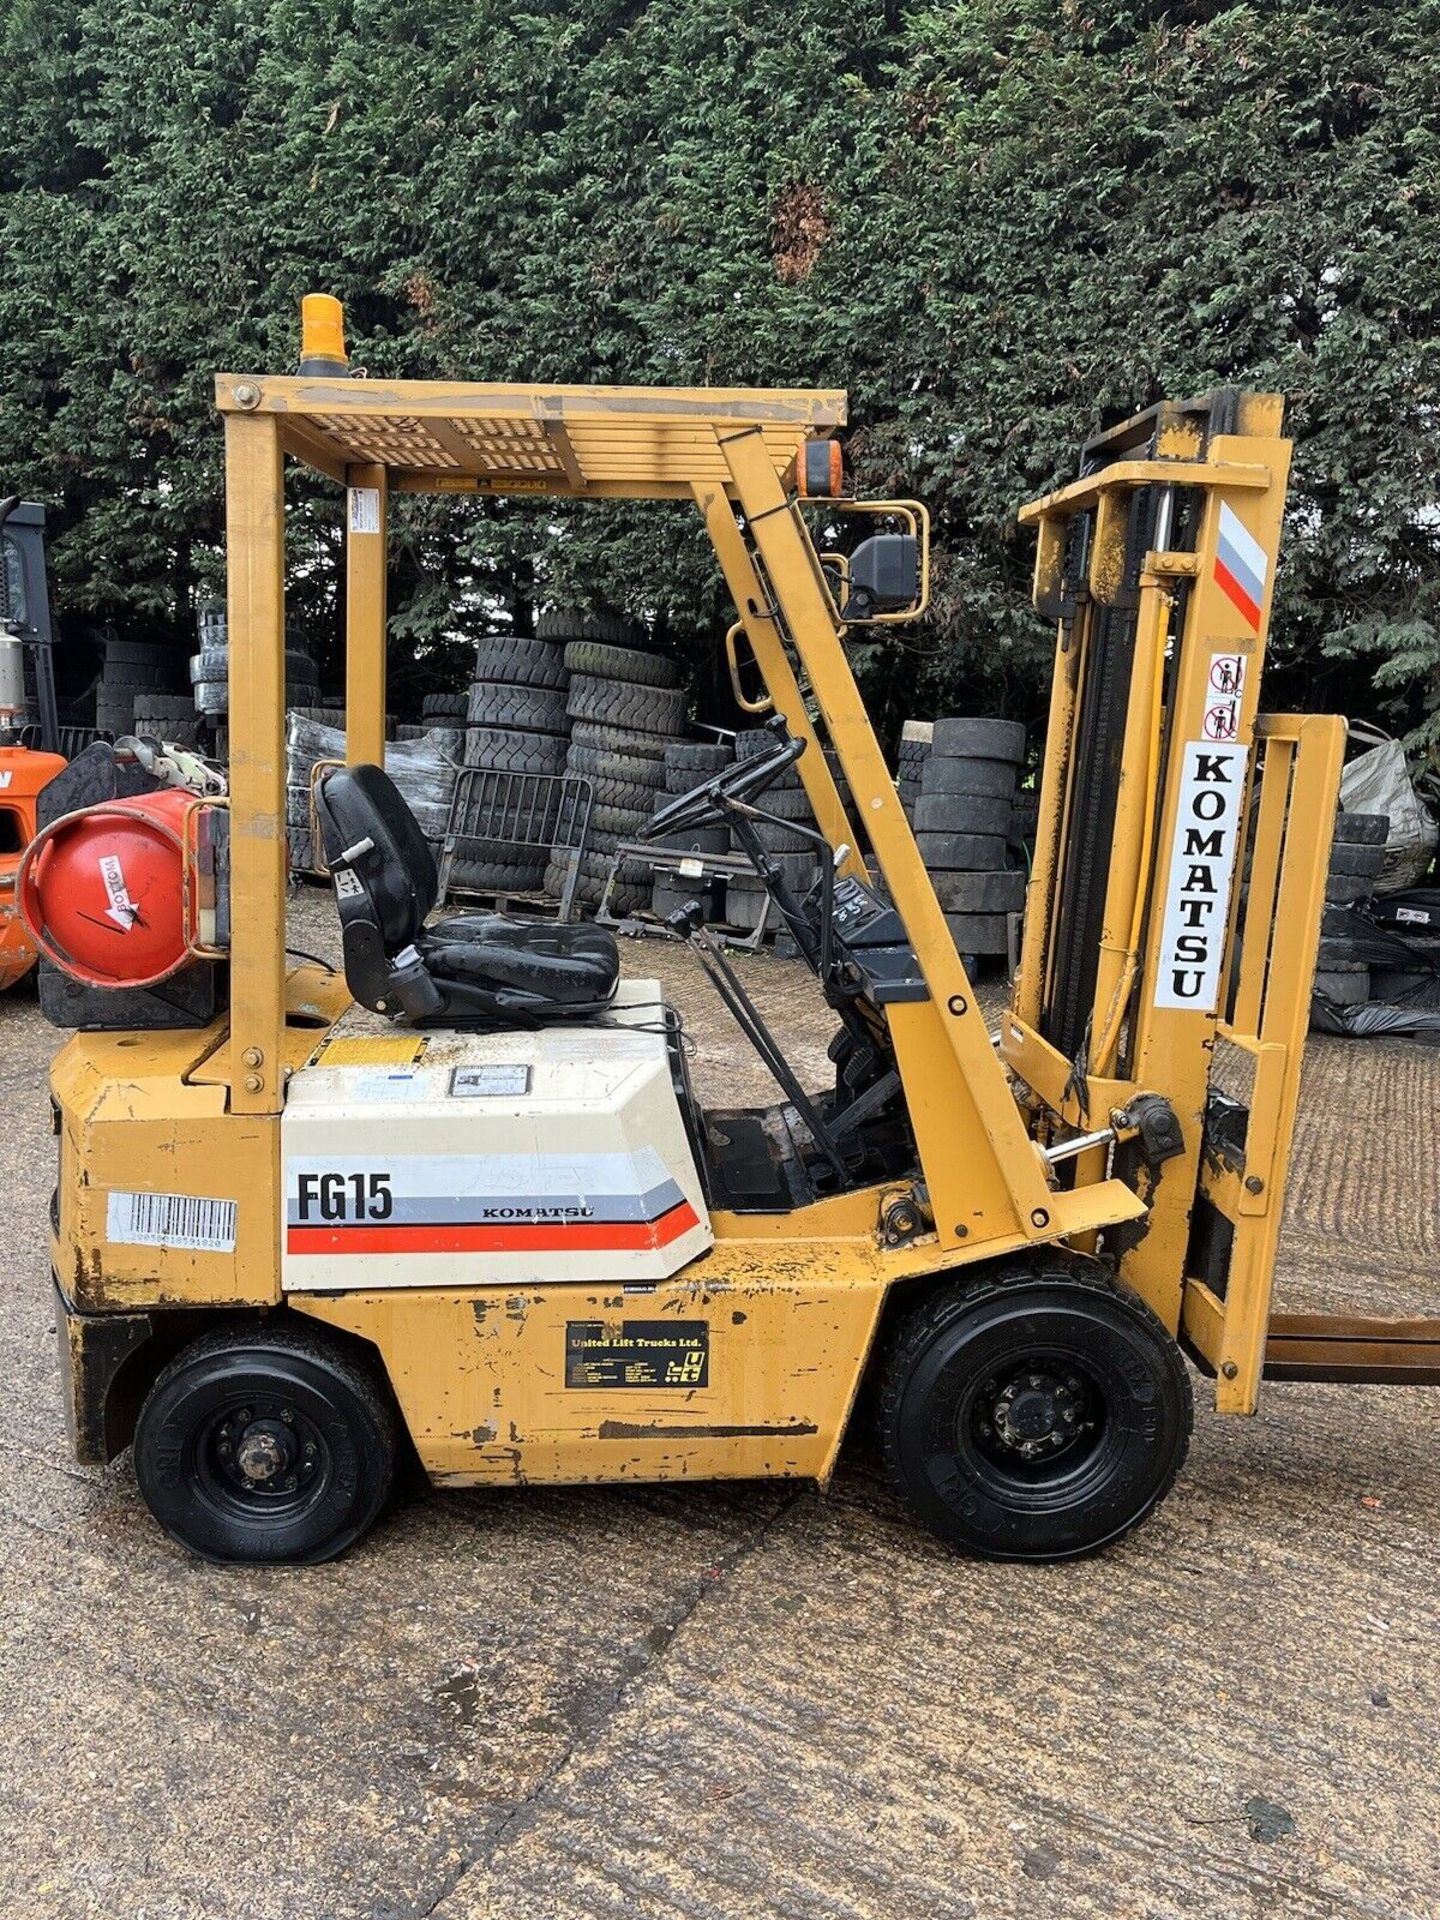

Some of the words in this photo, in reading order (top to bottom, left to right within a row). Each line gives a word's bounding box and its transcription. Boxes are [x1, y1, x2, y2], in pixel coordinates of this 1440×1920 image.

[105, 860, 127, 912] BOTTOM
[1172, 754, 1234, 998] KOMATSU
[298, 1173, 392, 1220] FG15
[483, 1207, 595, 1218] KOMATSU
[572, 1338, 610, 1347] United
[613, 1338, 633, 1347] Lift
[636, 1338, 677, 1347] Trucks
[679, 1338, 702, 1347] Ltd.
